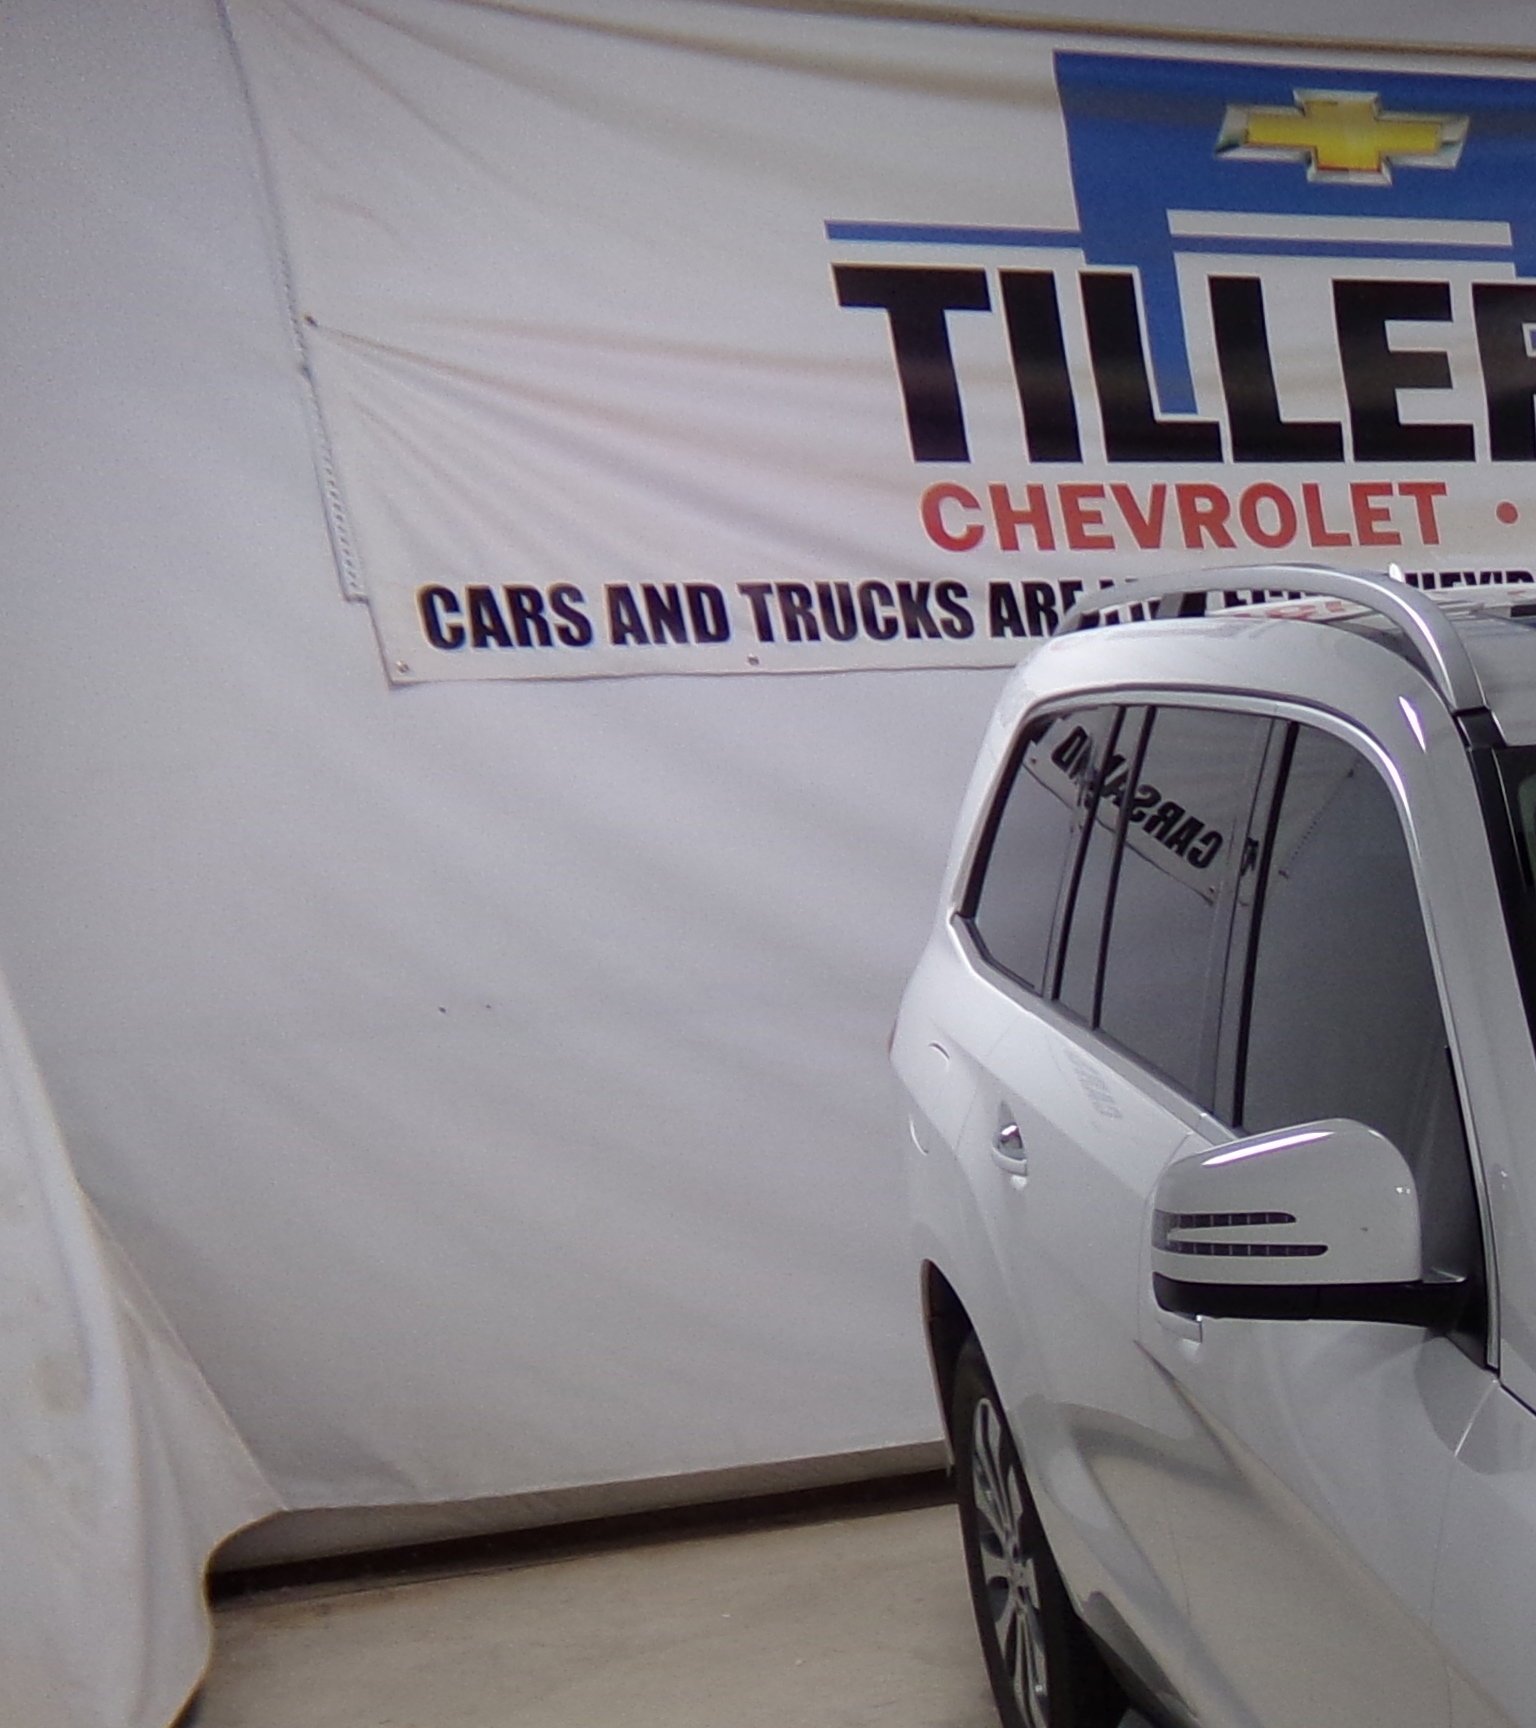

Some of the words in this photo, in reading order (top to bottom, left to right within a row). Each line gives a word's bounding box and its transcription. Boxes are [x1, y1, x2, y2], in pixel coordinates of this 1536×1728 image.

[920, 481, 1448, 552] CHEVROLET
[418, 583, 593, 650] CARS
[607, 583, 730, 645] AND
[738, 580, 975, 643] TRUCKS
